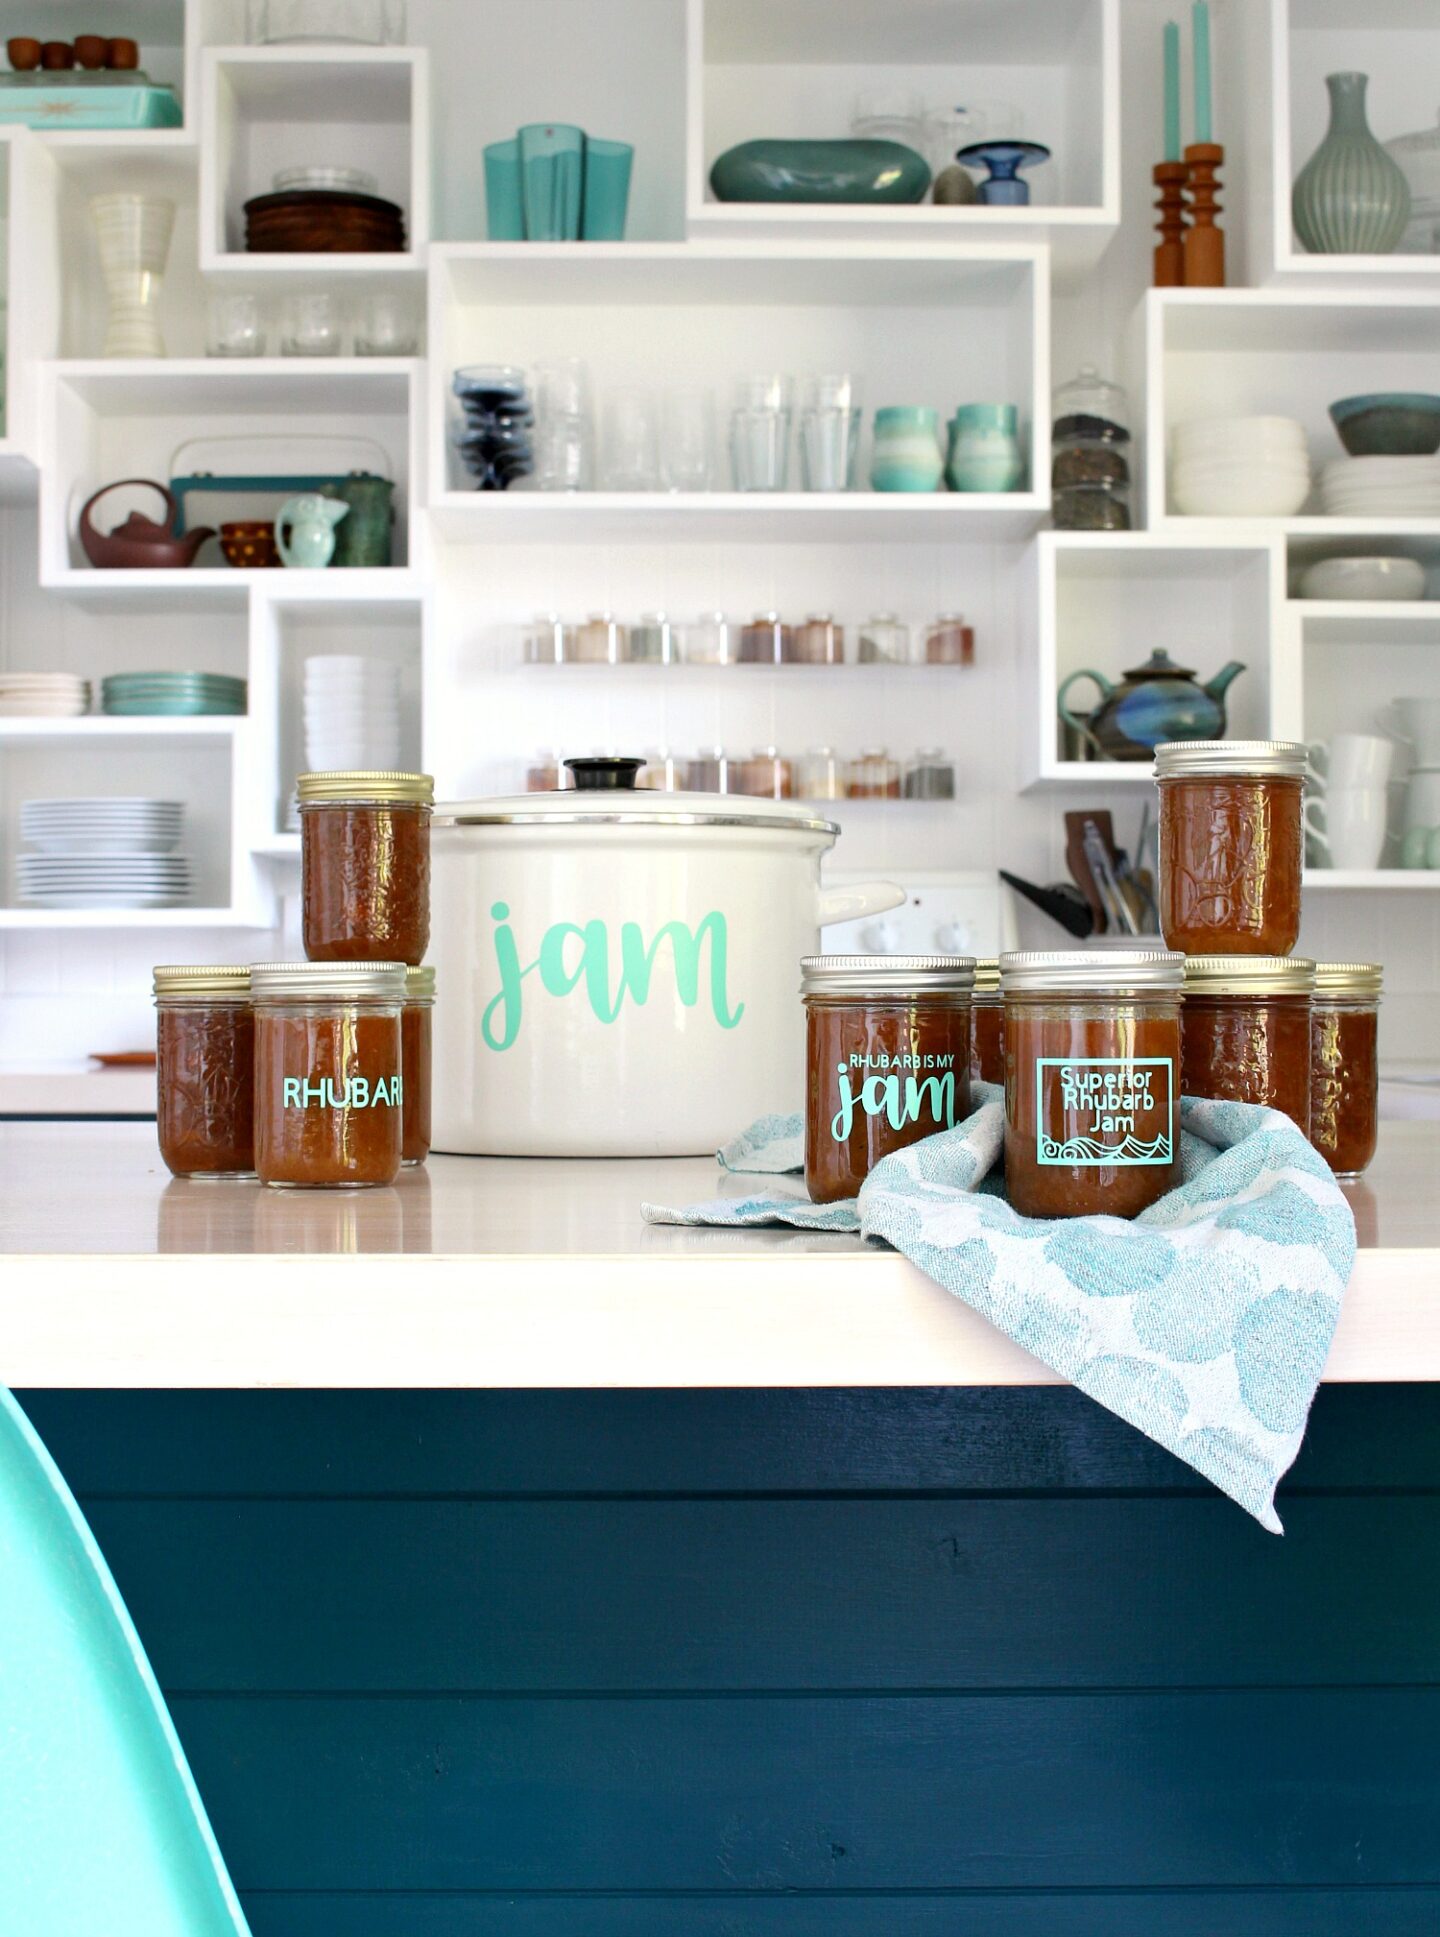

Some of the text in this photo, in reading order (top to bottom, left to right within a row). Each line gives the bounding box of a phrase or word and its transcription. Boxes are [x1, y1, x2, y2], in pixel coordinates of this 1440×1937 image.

[481, 901, 745, 1051] jam
[849, 1053, 955, 1069] RHUBARB IS MY
[283, 1076, 403, 1109] RHUBAR
[1060, 1066, 1153, 1094] Superior
[831, 1062, 961, 1142] jam
[1063, 1087, 1155, 1111] Rhubarb
[1089, 1109, 1135, 1132] Jam
